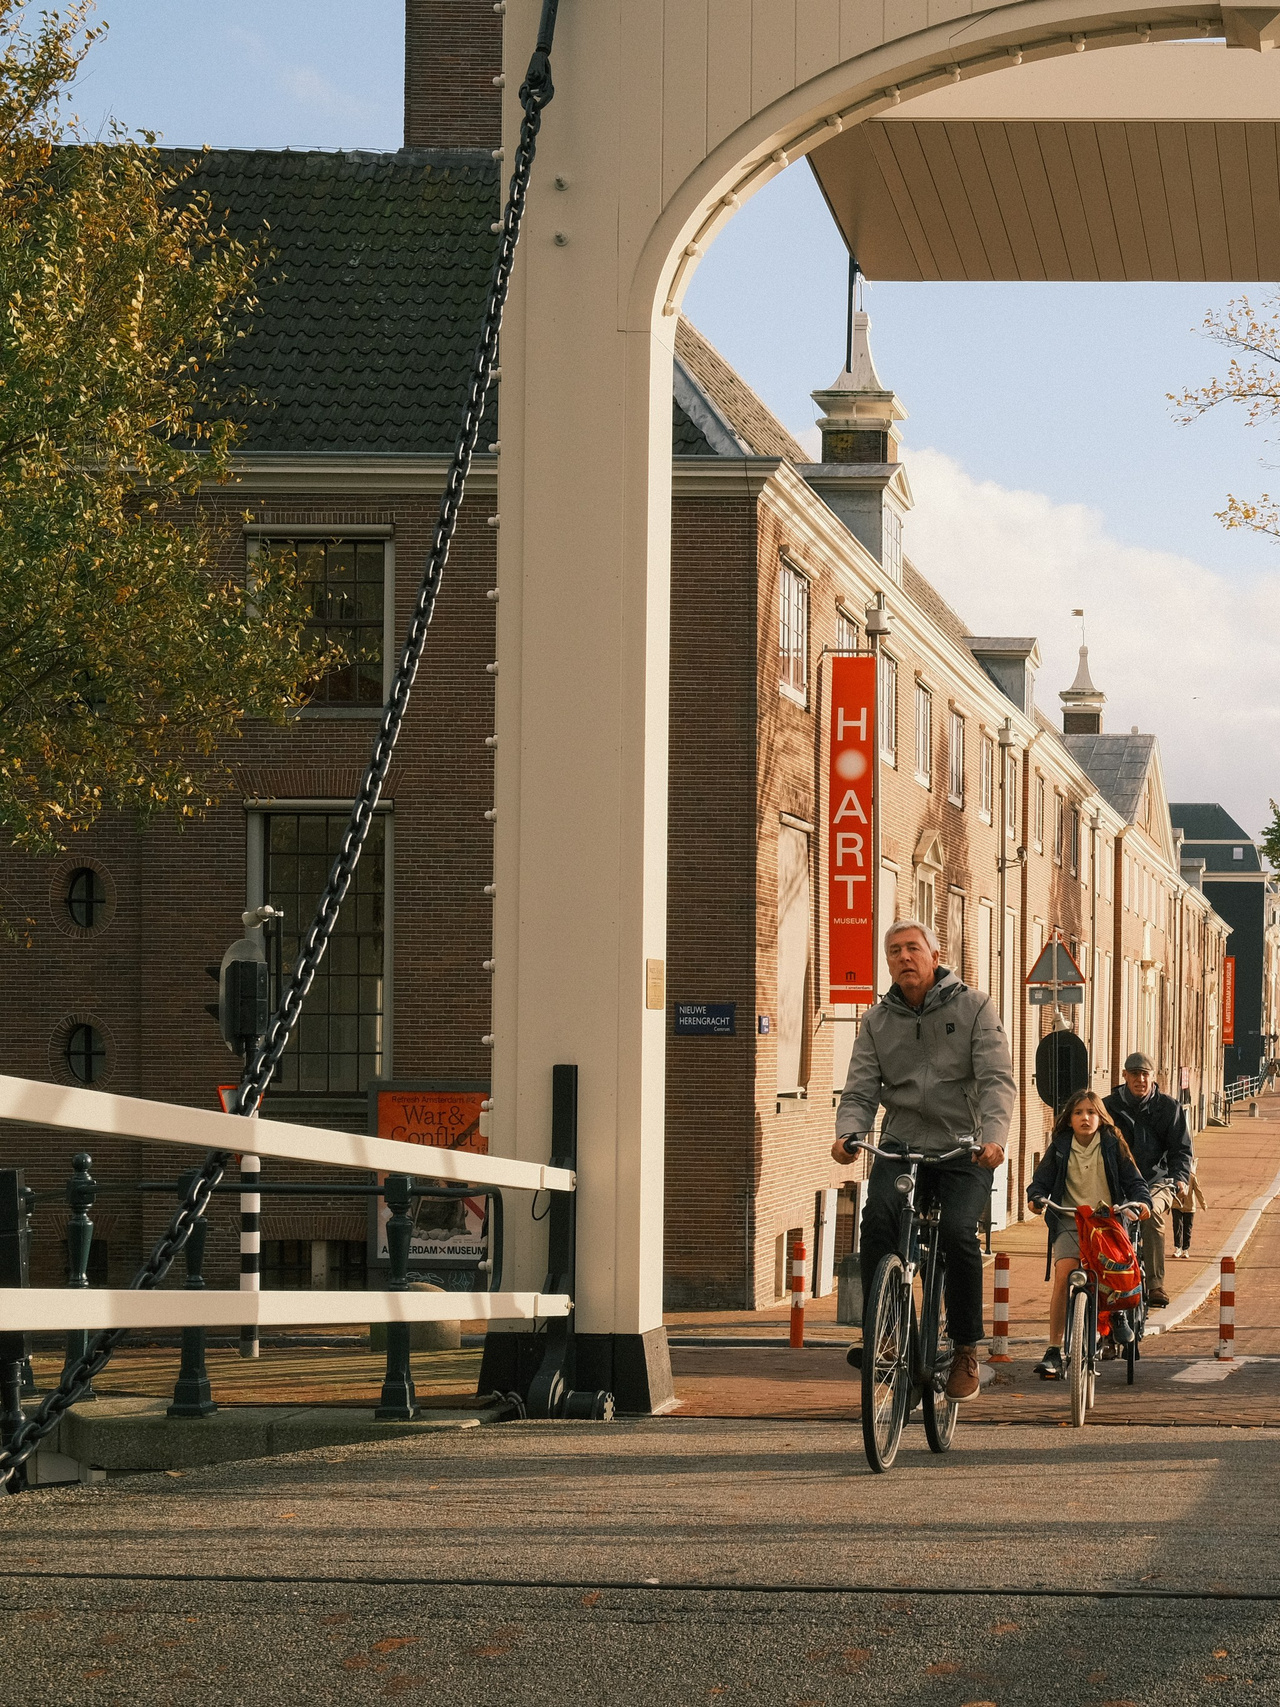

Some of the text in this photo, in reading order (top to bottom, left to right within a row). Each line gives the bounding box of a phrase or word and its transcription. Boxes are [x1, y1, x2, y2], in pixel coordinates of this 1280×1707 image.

[679, 1006, 707, 1015] NIEUWE
[679, 1017, 730, 1025] HERENGRACHT
[401, 1105, 446, 1125] War
[391, 1126, 477, 1147] Conflict
[382, 1245, 438, 1254] AERDAM
[447, 1246, 485, 1255] MUSEUM
